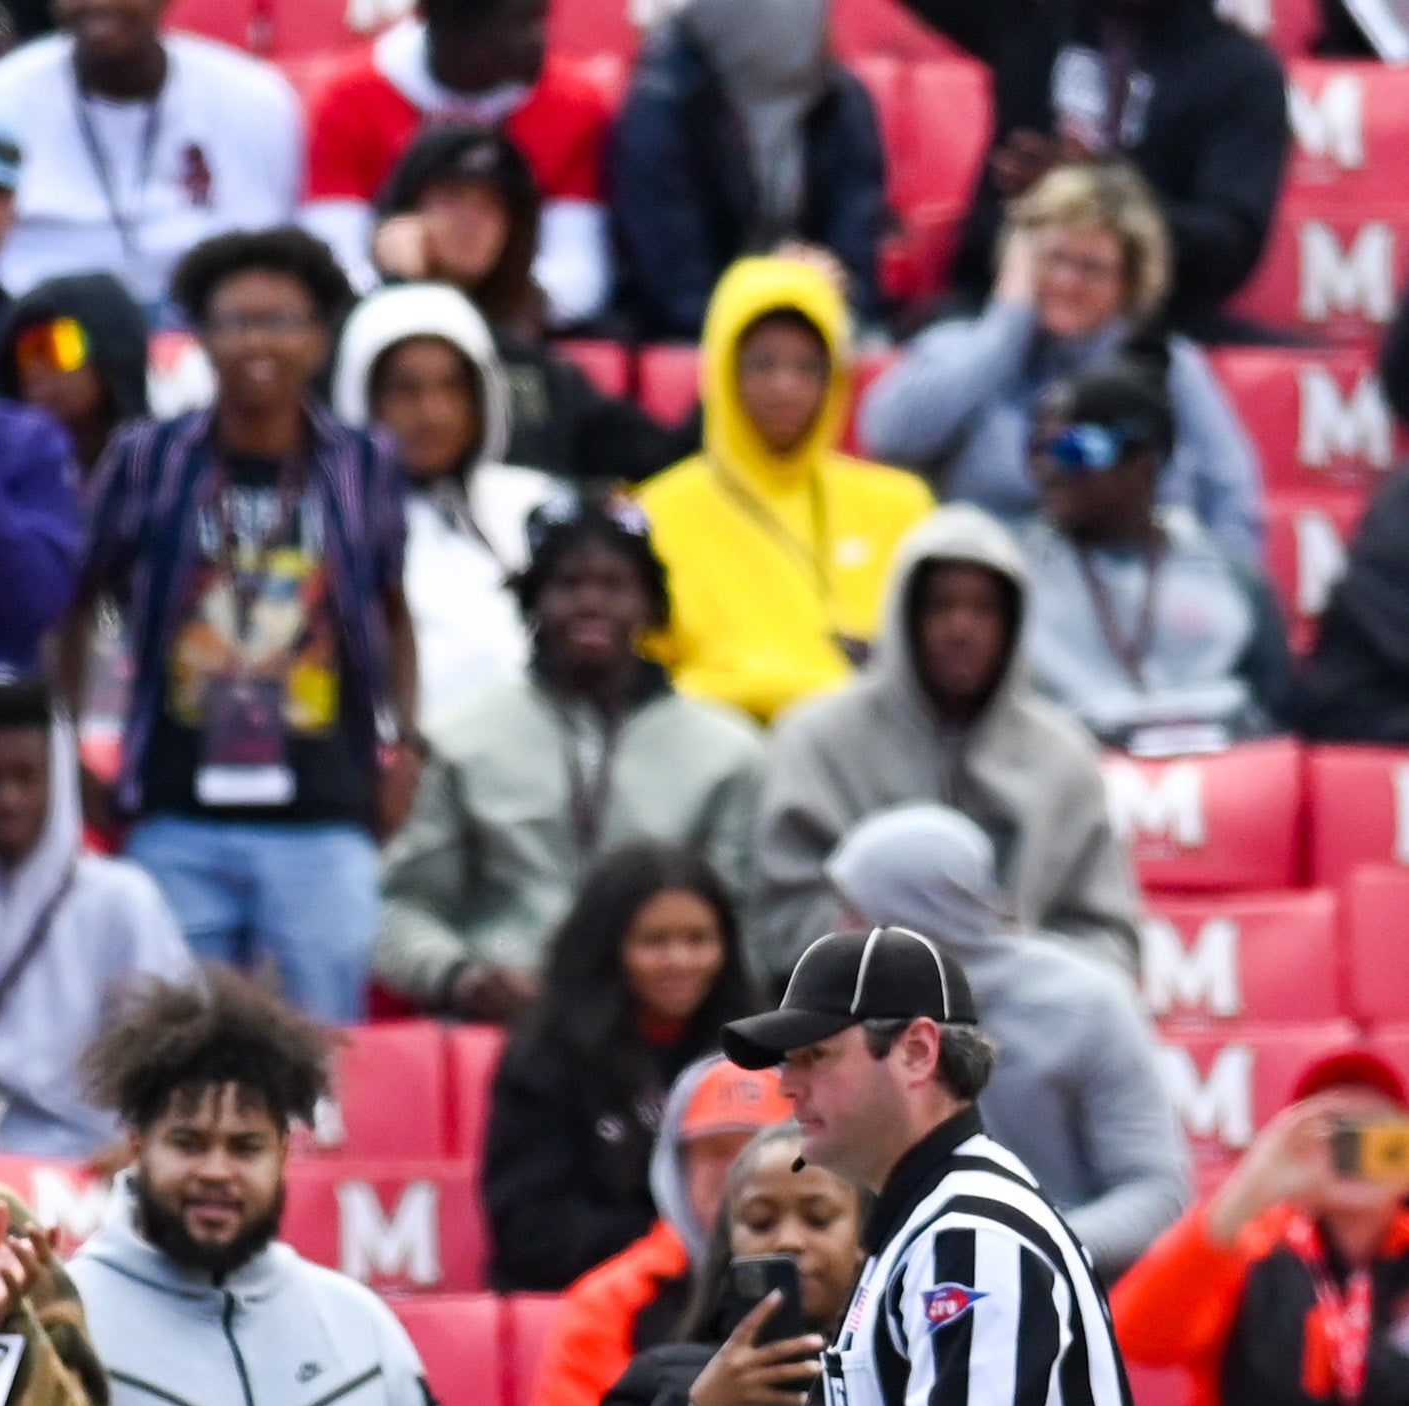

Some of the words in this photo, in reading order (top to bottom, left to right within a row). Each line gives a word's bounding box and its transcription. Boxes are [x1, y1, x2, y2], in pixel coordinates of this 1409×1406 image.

[1289, 76, 1363, 170] M
[1299, 219, 1398, 323] M
[1298, 362, 1394, 471] M
[1107, 764, 1204, 848] M
[1142, 918, 1239, 1016] M
[1160, 1045, 1254, 1147] M
[339, 1179, 440, 1285] M
